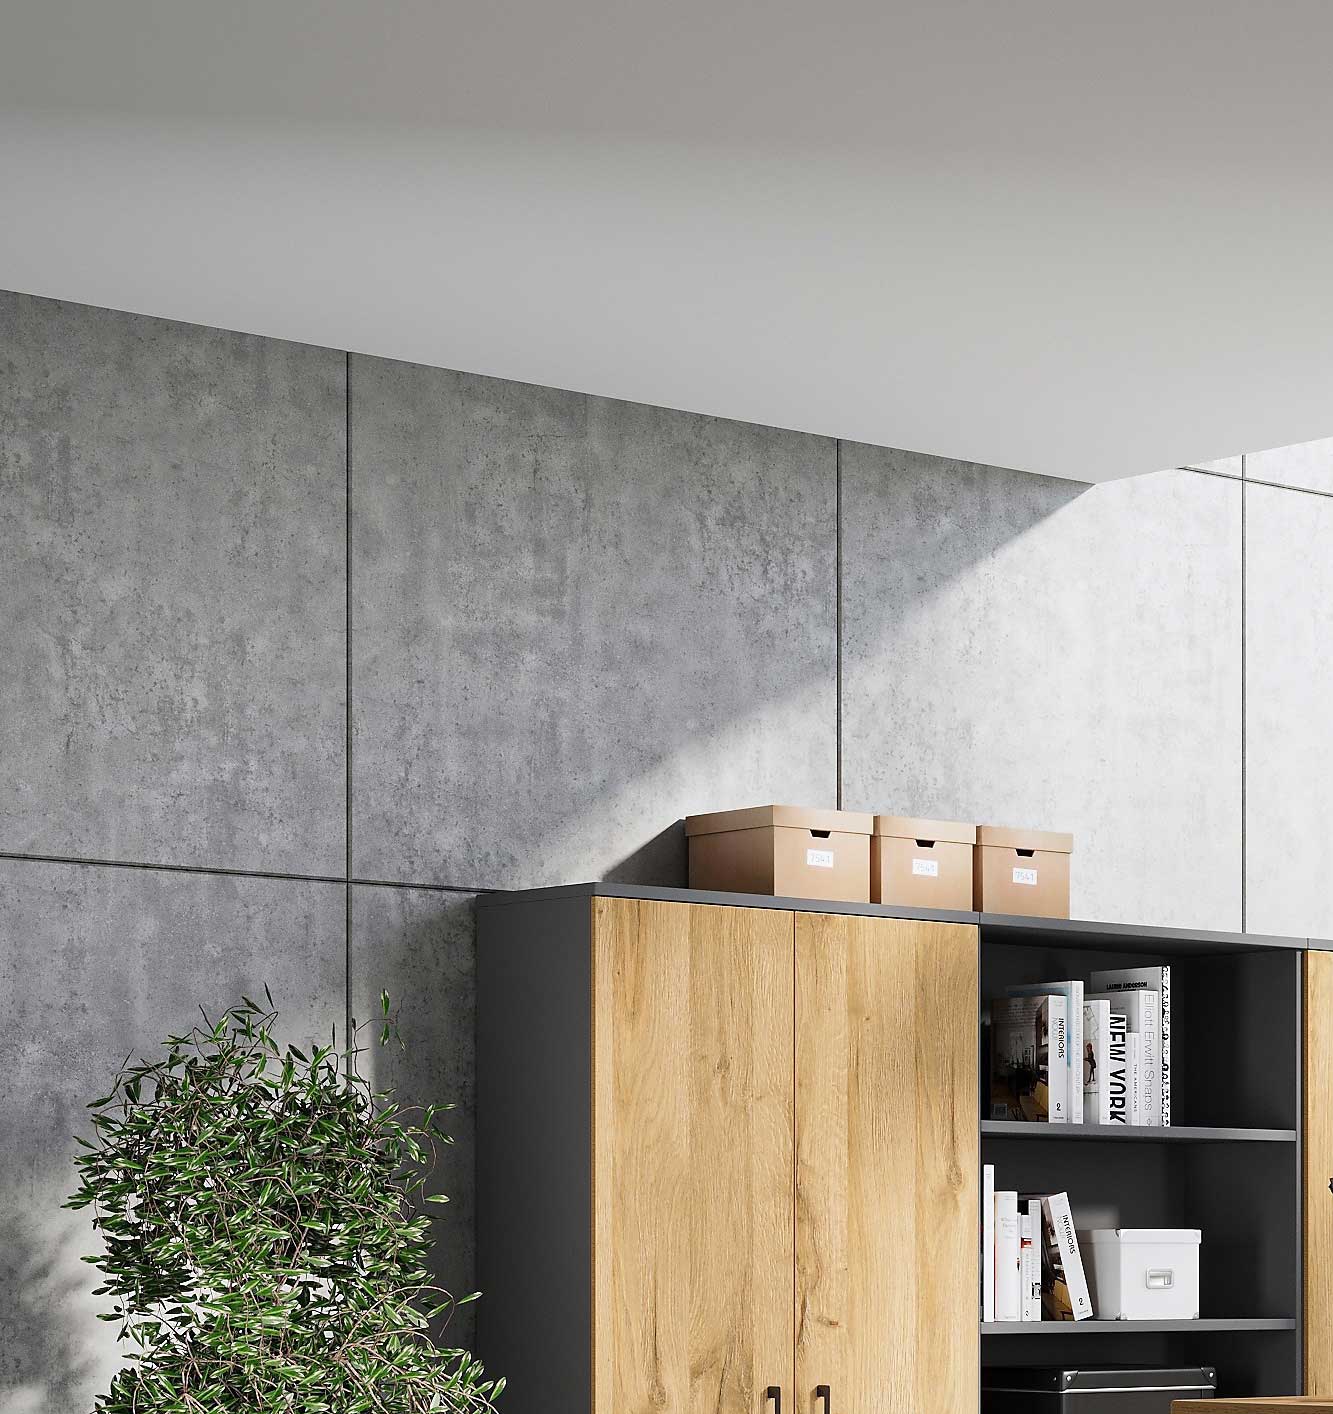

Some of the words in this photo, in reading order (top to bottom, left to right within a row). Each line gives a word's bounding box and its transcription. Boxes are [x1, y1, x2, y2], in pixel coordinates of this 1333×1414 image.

[1144, 994, 1154, 1026] Elliott
[1110, 1016, 1126, 1062] NEW
[1144, 1031, 1154, 1065] Erwitt
[1056, 1102, 1061, 1112] 2
[1110, 1068, 1126, 1124] YORK
[1144, 1070, 1155, 1111] Snaps
[1063, 1215, 1076, 1254] INTERIORS
[1078, 1297, 1084, 1306] 2
